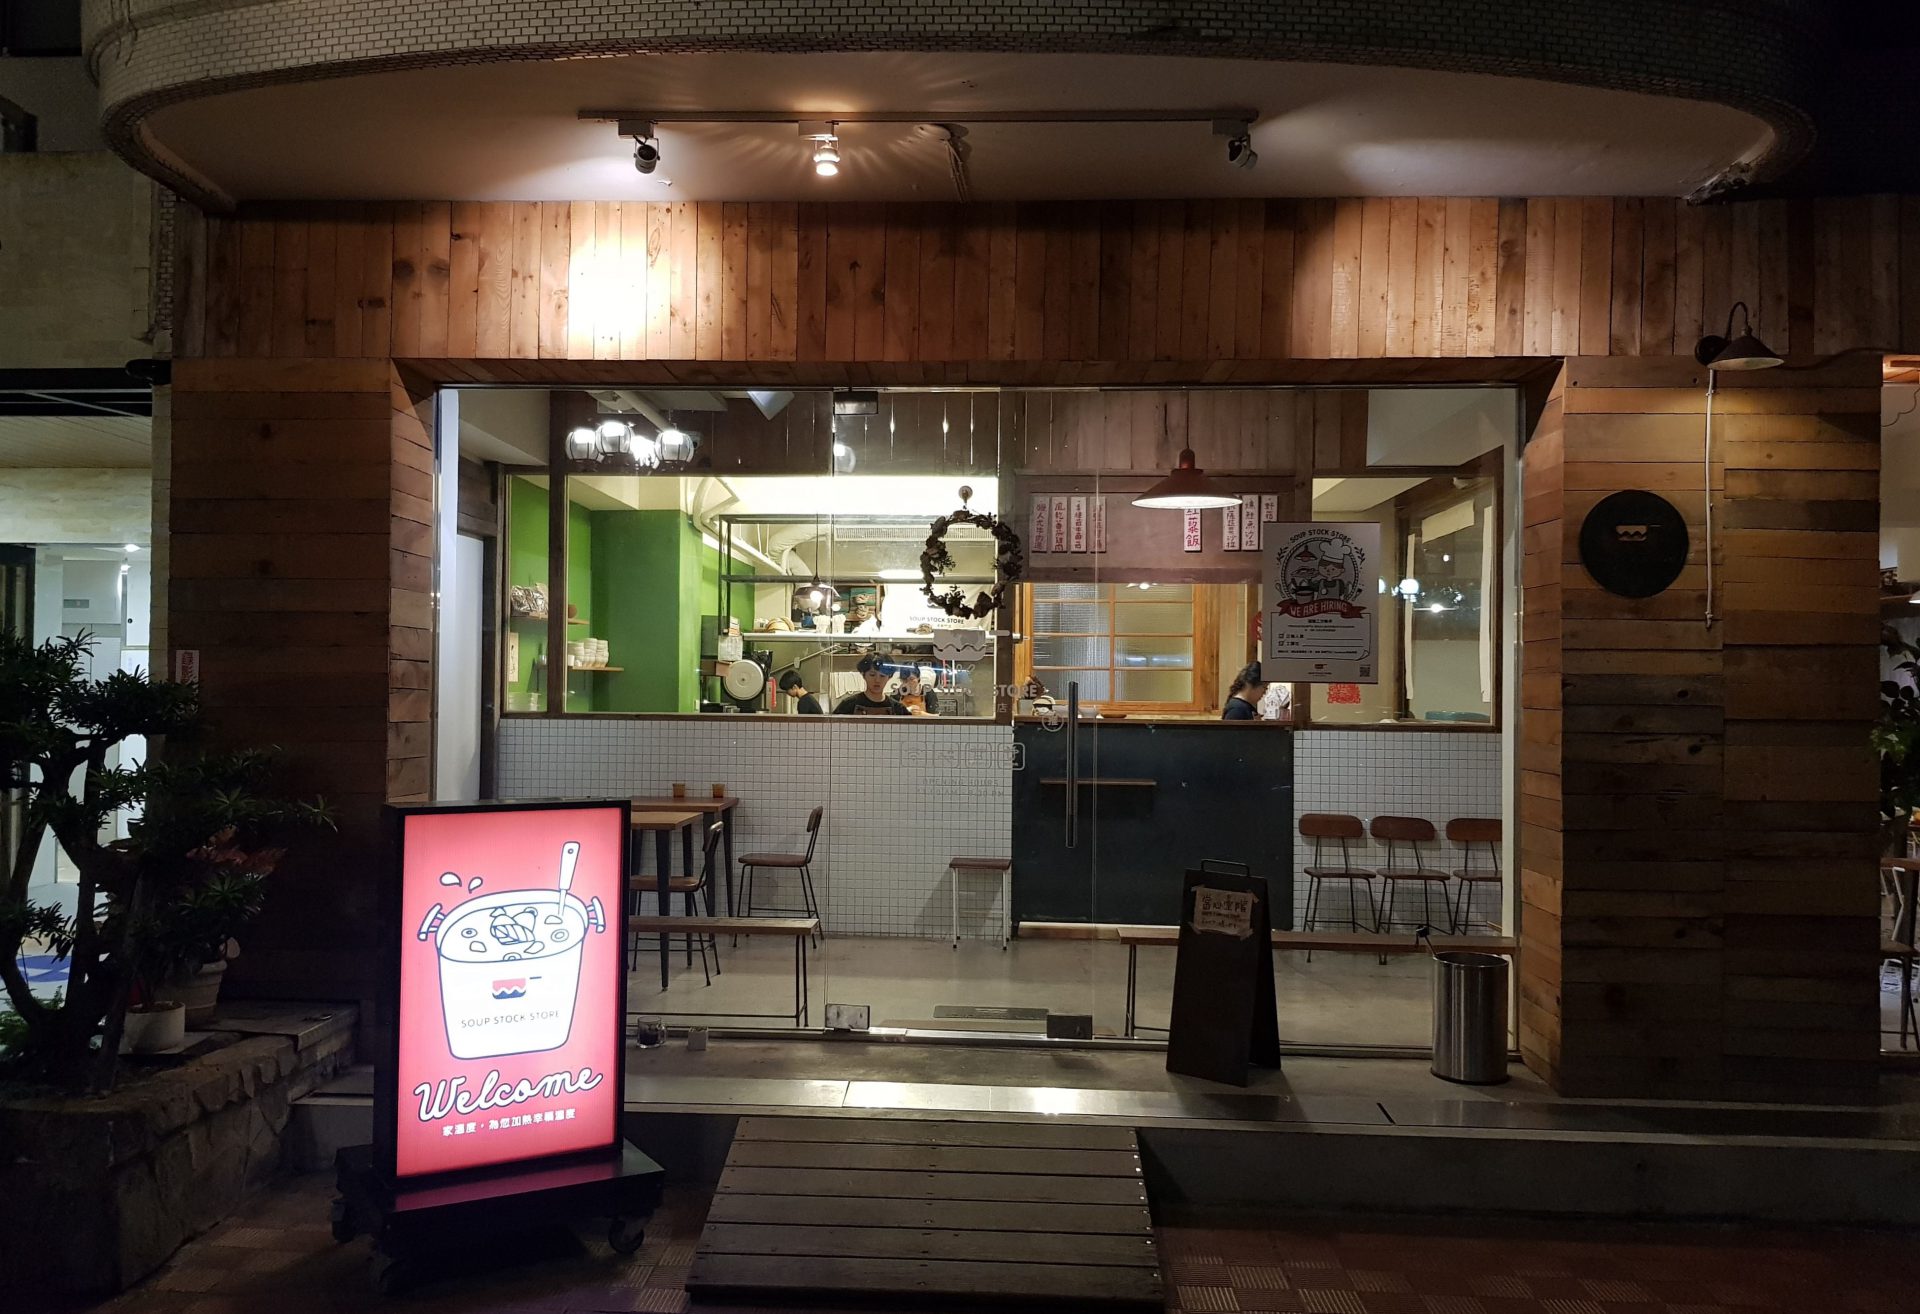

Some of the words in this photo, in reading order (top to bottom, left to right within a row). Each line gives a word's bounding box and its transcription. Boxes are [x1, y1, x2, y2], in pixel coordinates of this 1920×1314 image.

[1289, 531, 1306, 543] SOUP
[1290, 607, 1302, 616] WE
[1303, 603, 1319, 615] ARE
[1320, 600, 1348, 612] HIRING
[992, 684, 1038, 698] STORE
[461, 1016, 490, 1029] SOUP
[493, 1013, 526, 1025] STOCK
[529, 1009, 560, 1021] STORE
[414, 1066, 603, 1122] Welcome
